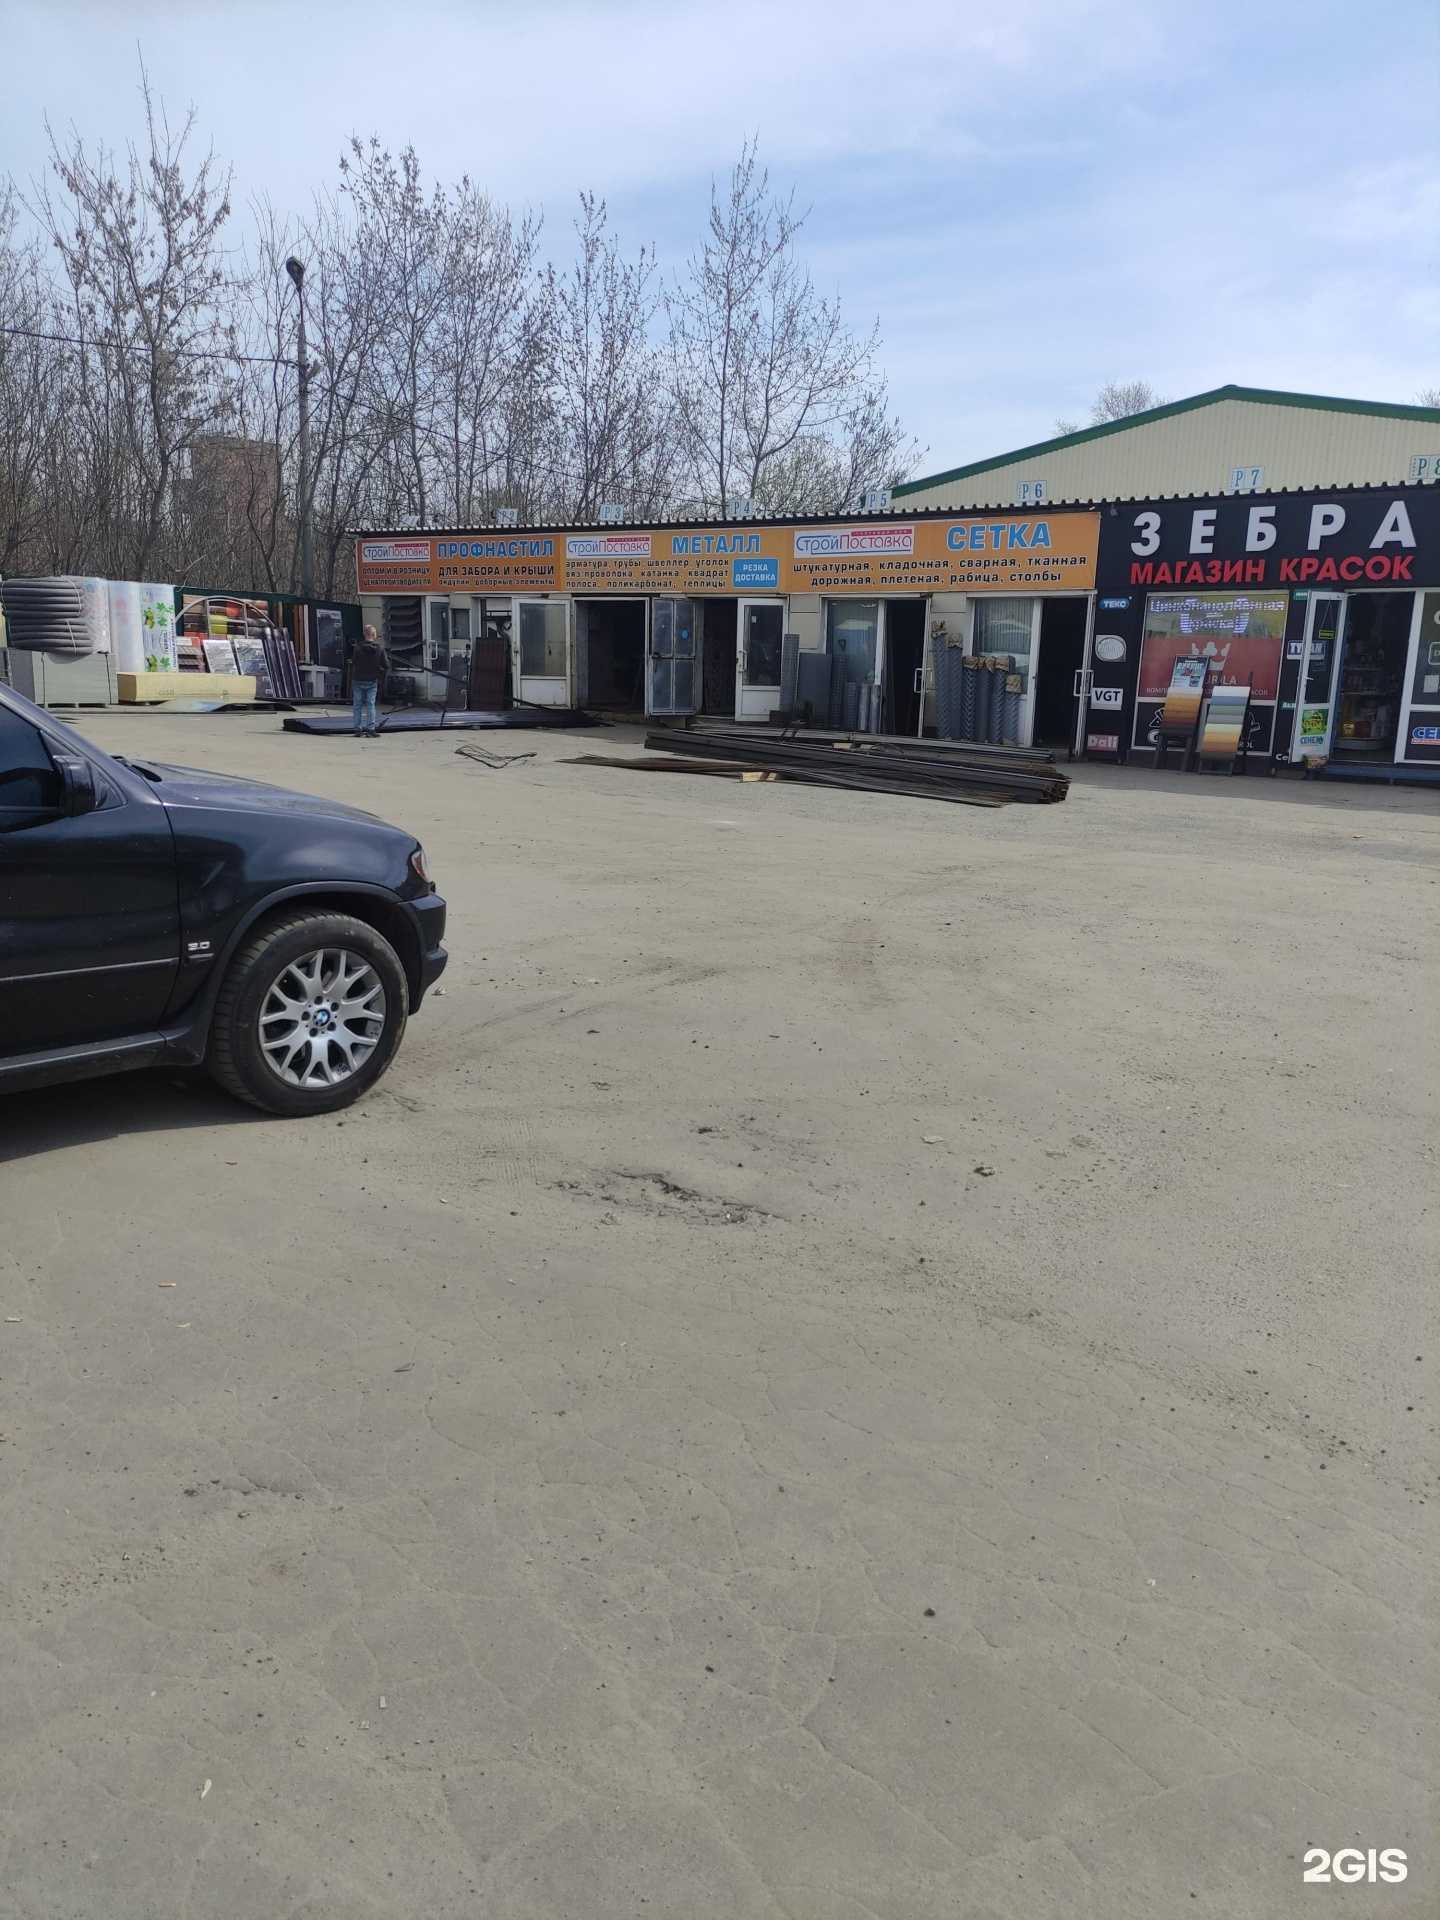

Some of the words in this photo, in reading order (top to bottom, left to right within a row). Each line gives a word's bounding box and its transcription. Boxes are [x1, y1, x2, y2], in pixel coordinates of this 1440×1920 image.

[947, 522, 1051, 550] СЕТКА
[1130, 500, 1417, 557] ЗЕБРА
[437, 540, 554, 558] ПРОФНАСТИЛ
[671, 534, 761, 554] МЕТАЛЛ
[796, 534, 912, 555] СтройПоставка
[743, 563, 769, 572] РЕЗКА
[1028, 556, 1087, 566] тканная
[439, 566, 458, 577] ДЛЯ
[461, 566, 500, 576] ЗАБОРА
[503, 566, 510, 576] И
[514, 565, 555, 575] КРЫШИ
[735, 573, 776, 582] ДОСТАВКА
[1009, 571, 1061, 581] столбы
[1130, 559, 1265, 585] МАГАЗИН
[1279, 555, 1415, 582] КРАСОК
[1094, 690, 1121, 702] VGT
